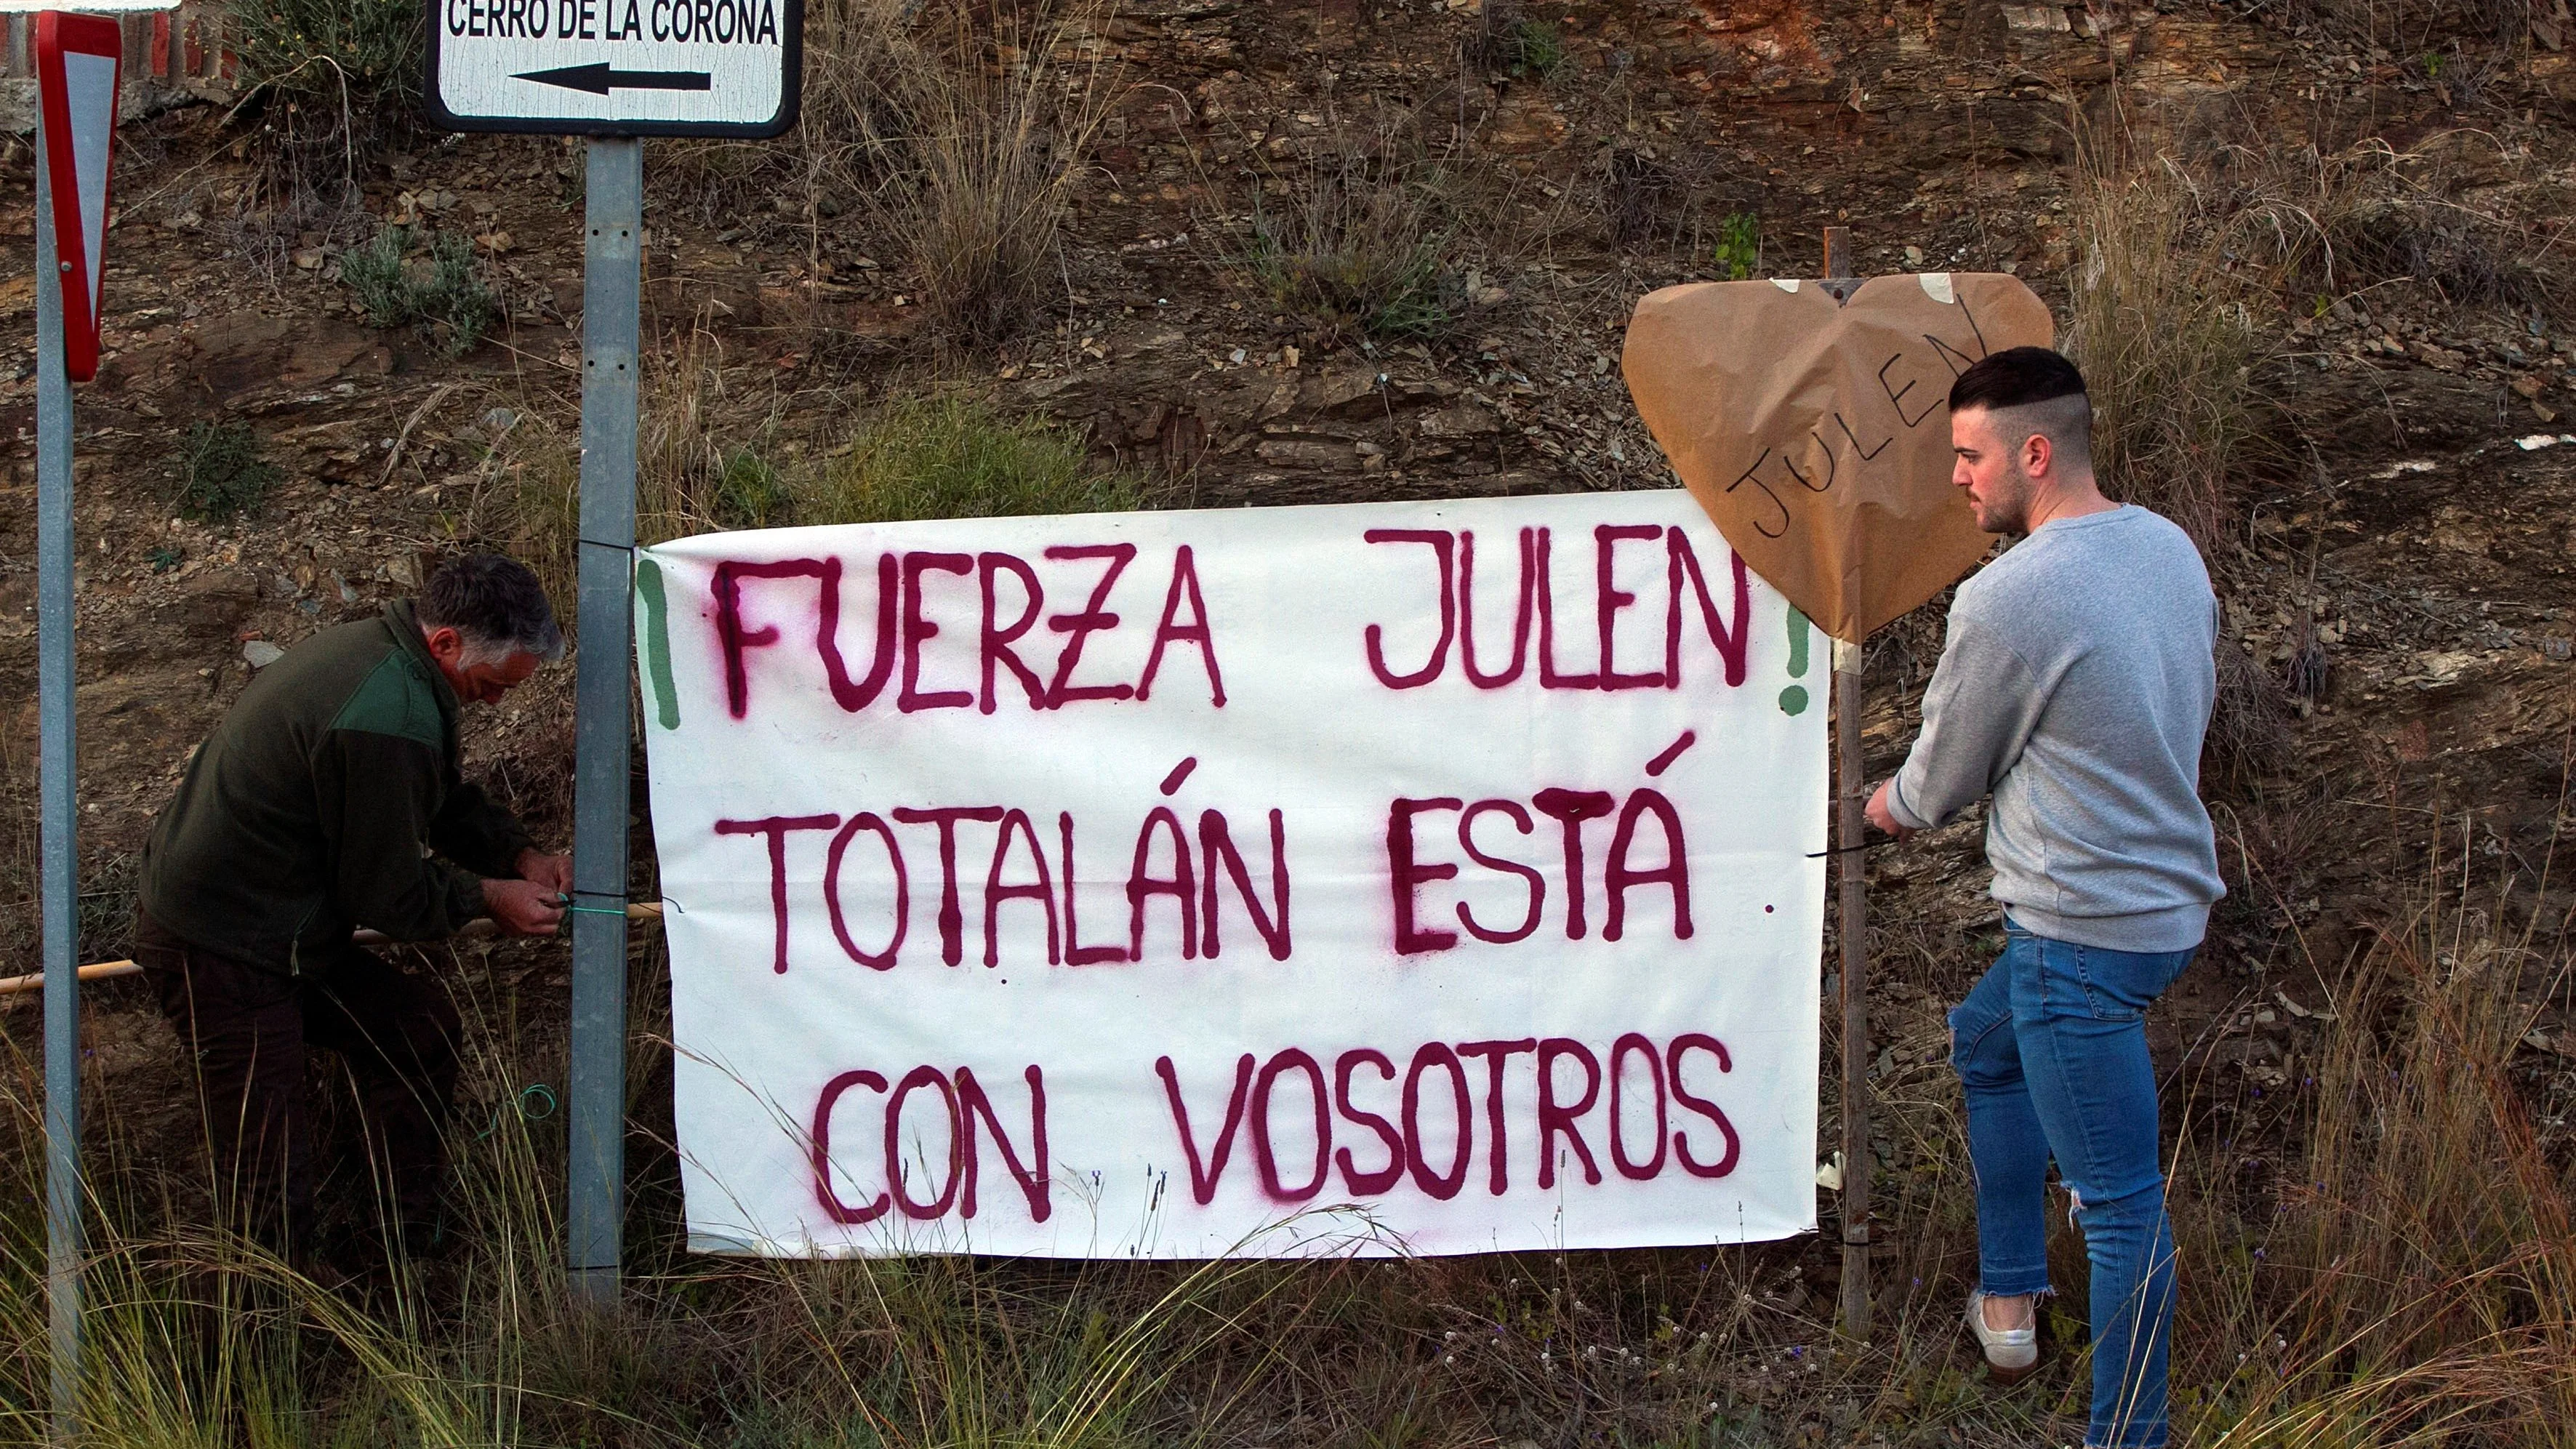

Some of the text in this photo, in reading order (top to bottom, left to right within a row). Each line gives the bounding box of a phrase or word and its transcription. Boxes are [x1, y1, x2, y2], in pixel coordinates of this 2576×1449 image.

[448, 0, 777, 45] CERRO DE LA CORONA
[715, 729, 1696, 974] TOTALÁN ESTÁ
[812, 1032, 1741, 1224] CON VOSOTROS
